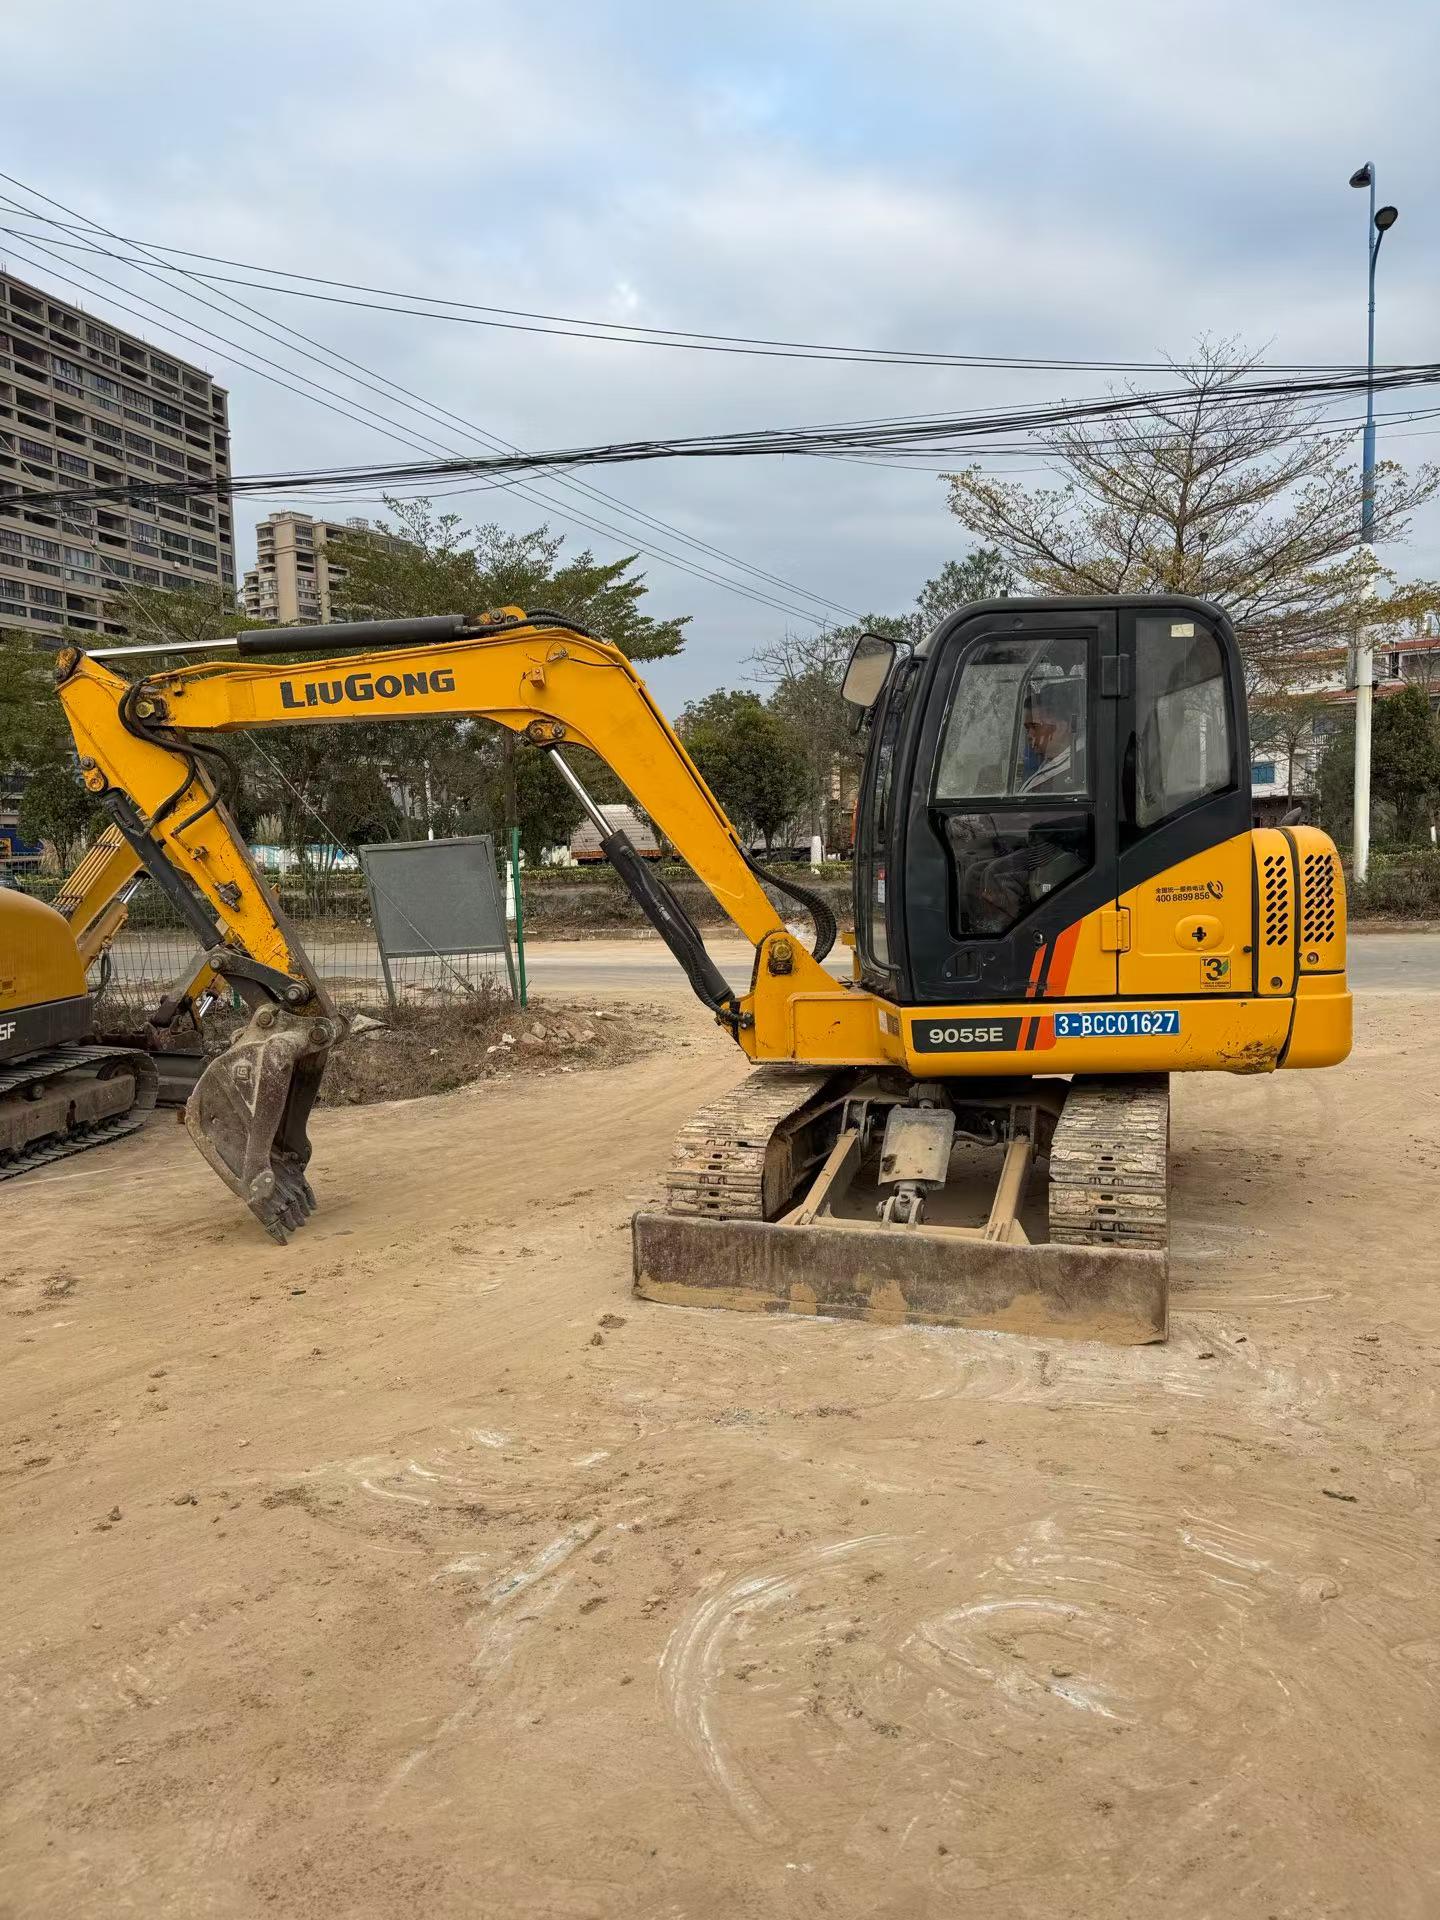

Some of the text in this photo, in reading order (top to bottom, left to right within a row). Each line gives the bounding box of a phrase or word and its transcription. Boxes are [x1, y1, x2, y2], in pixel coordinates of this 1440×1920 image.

[280, 668, 456, 709] LIUGONG
[1155, 891, 1210, 903] 400 8899 856
[1058, 1013, 1176, 1035] 3-BCC01627
[928, 1026, 1004, 1044] 9055E
